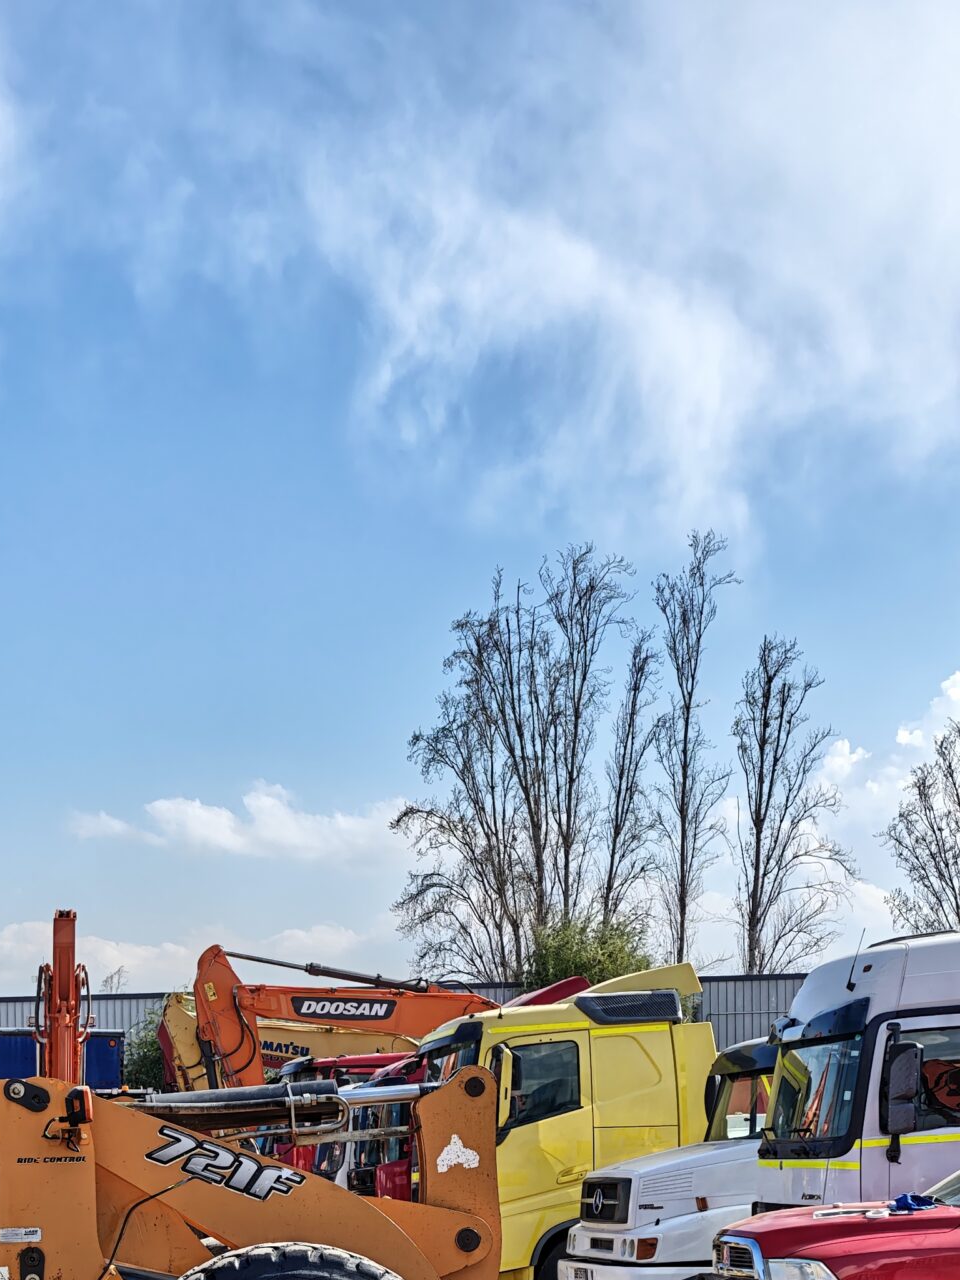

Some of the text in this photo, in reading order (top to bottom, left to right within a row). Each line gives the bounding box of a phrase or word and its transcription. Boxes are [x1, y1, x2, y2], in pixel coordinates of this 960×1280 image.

[300, 1000, 388, 1017] DOOSAN
[259, 1040, 310, 1057] MATSU
[145, 1125, 306, 1200] 721F
